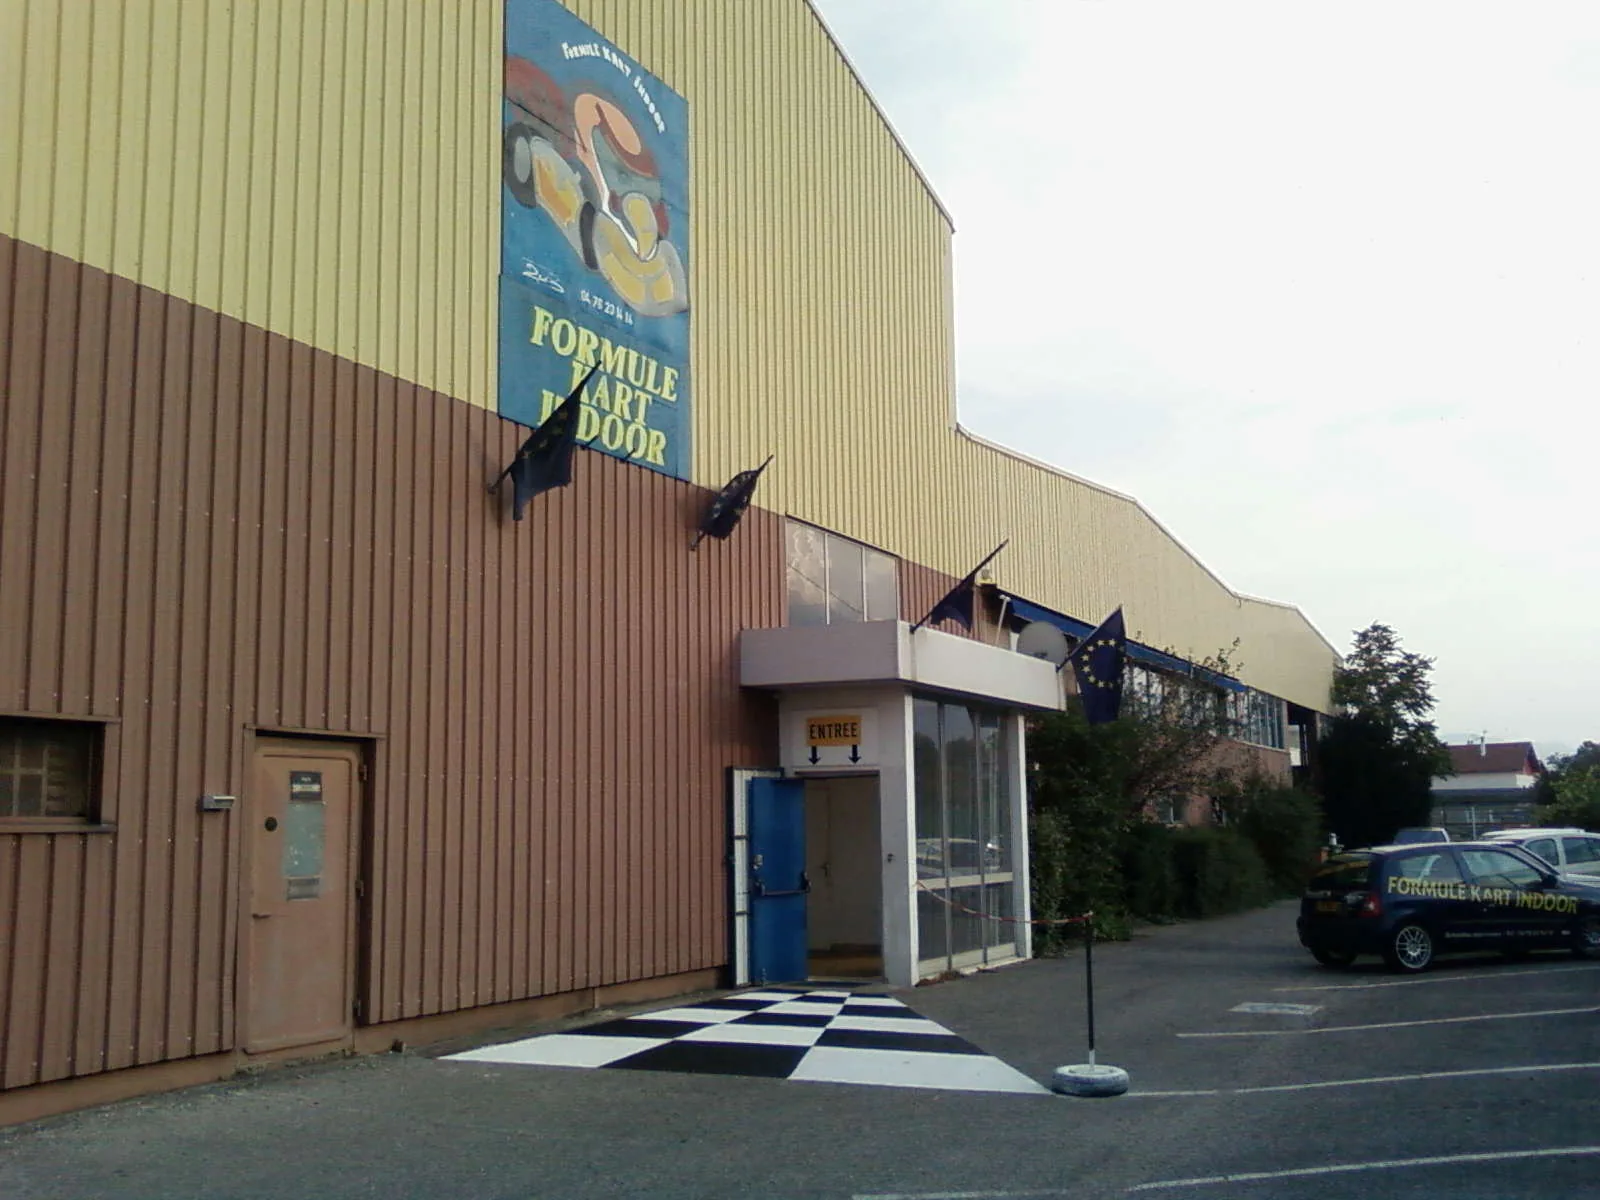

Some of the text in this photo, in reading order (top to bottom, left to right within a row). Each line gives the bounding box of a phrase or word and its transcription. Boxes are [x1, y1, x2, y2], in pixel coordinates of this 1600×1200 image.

[530, 306, 679, 402] FORMULE
[537, 388, 667, 466] IDOOR
[809, 722, 859, 739] ENTREE
[1387, 876, 1578, 914] FORMULE KART INDOOR
